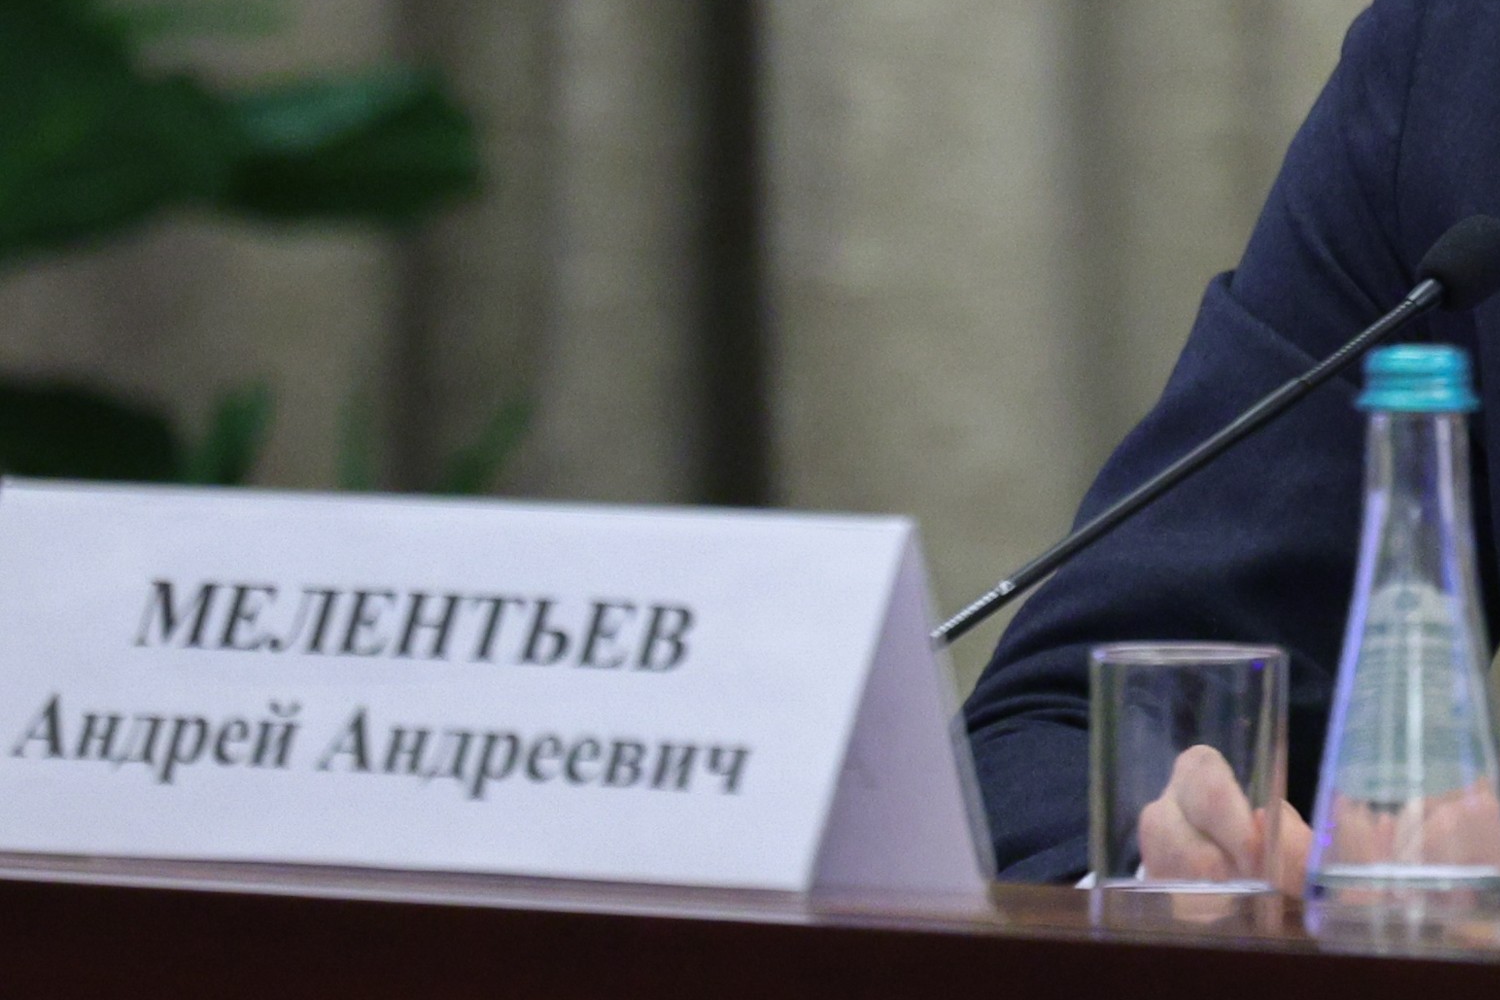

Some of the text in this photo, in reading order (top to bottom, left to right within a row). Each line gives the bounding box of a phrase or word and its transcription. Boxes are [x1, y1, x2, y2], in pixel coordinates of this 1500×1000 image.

[136, 579, 695, 672] МЕЛЕНТЬЕВ
[13, 693, 750, 799] Андрей Андреевич
